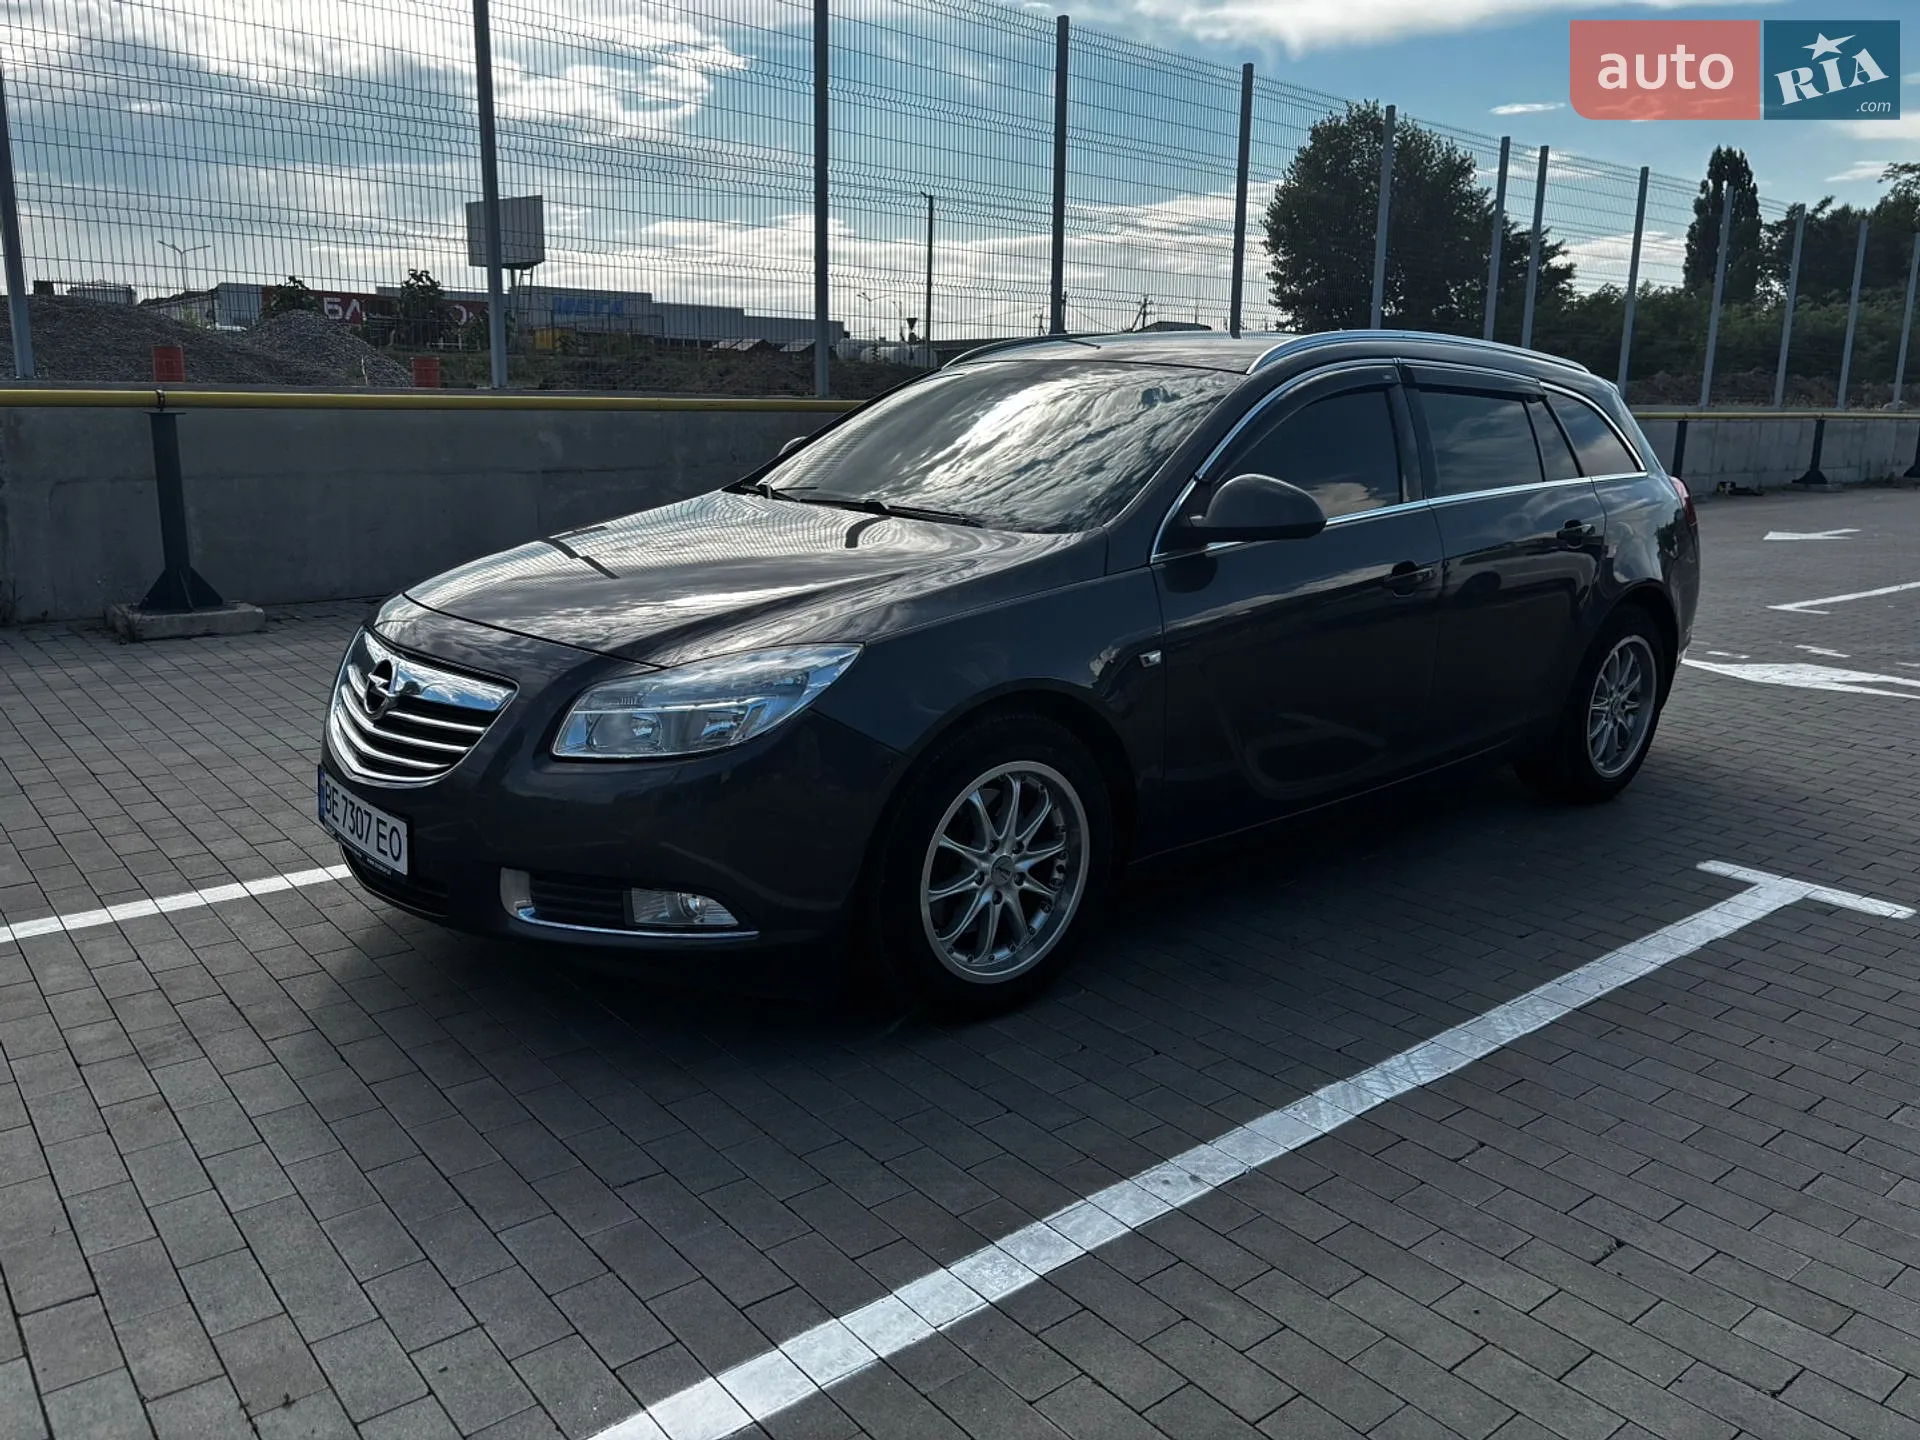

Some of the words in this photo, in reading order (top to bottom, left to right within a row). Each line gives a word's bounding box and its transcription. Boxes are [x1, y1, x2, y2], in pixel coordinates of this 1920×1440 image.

[325, 782, 339, 823] BE
[342, 796, 372, 844] 7307
[378, 819, 402, 861] EO
